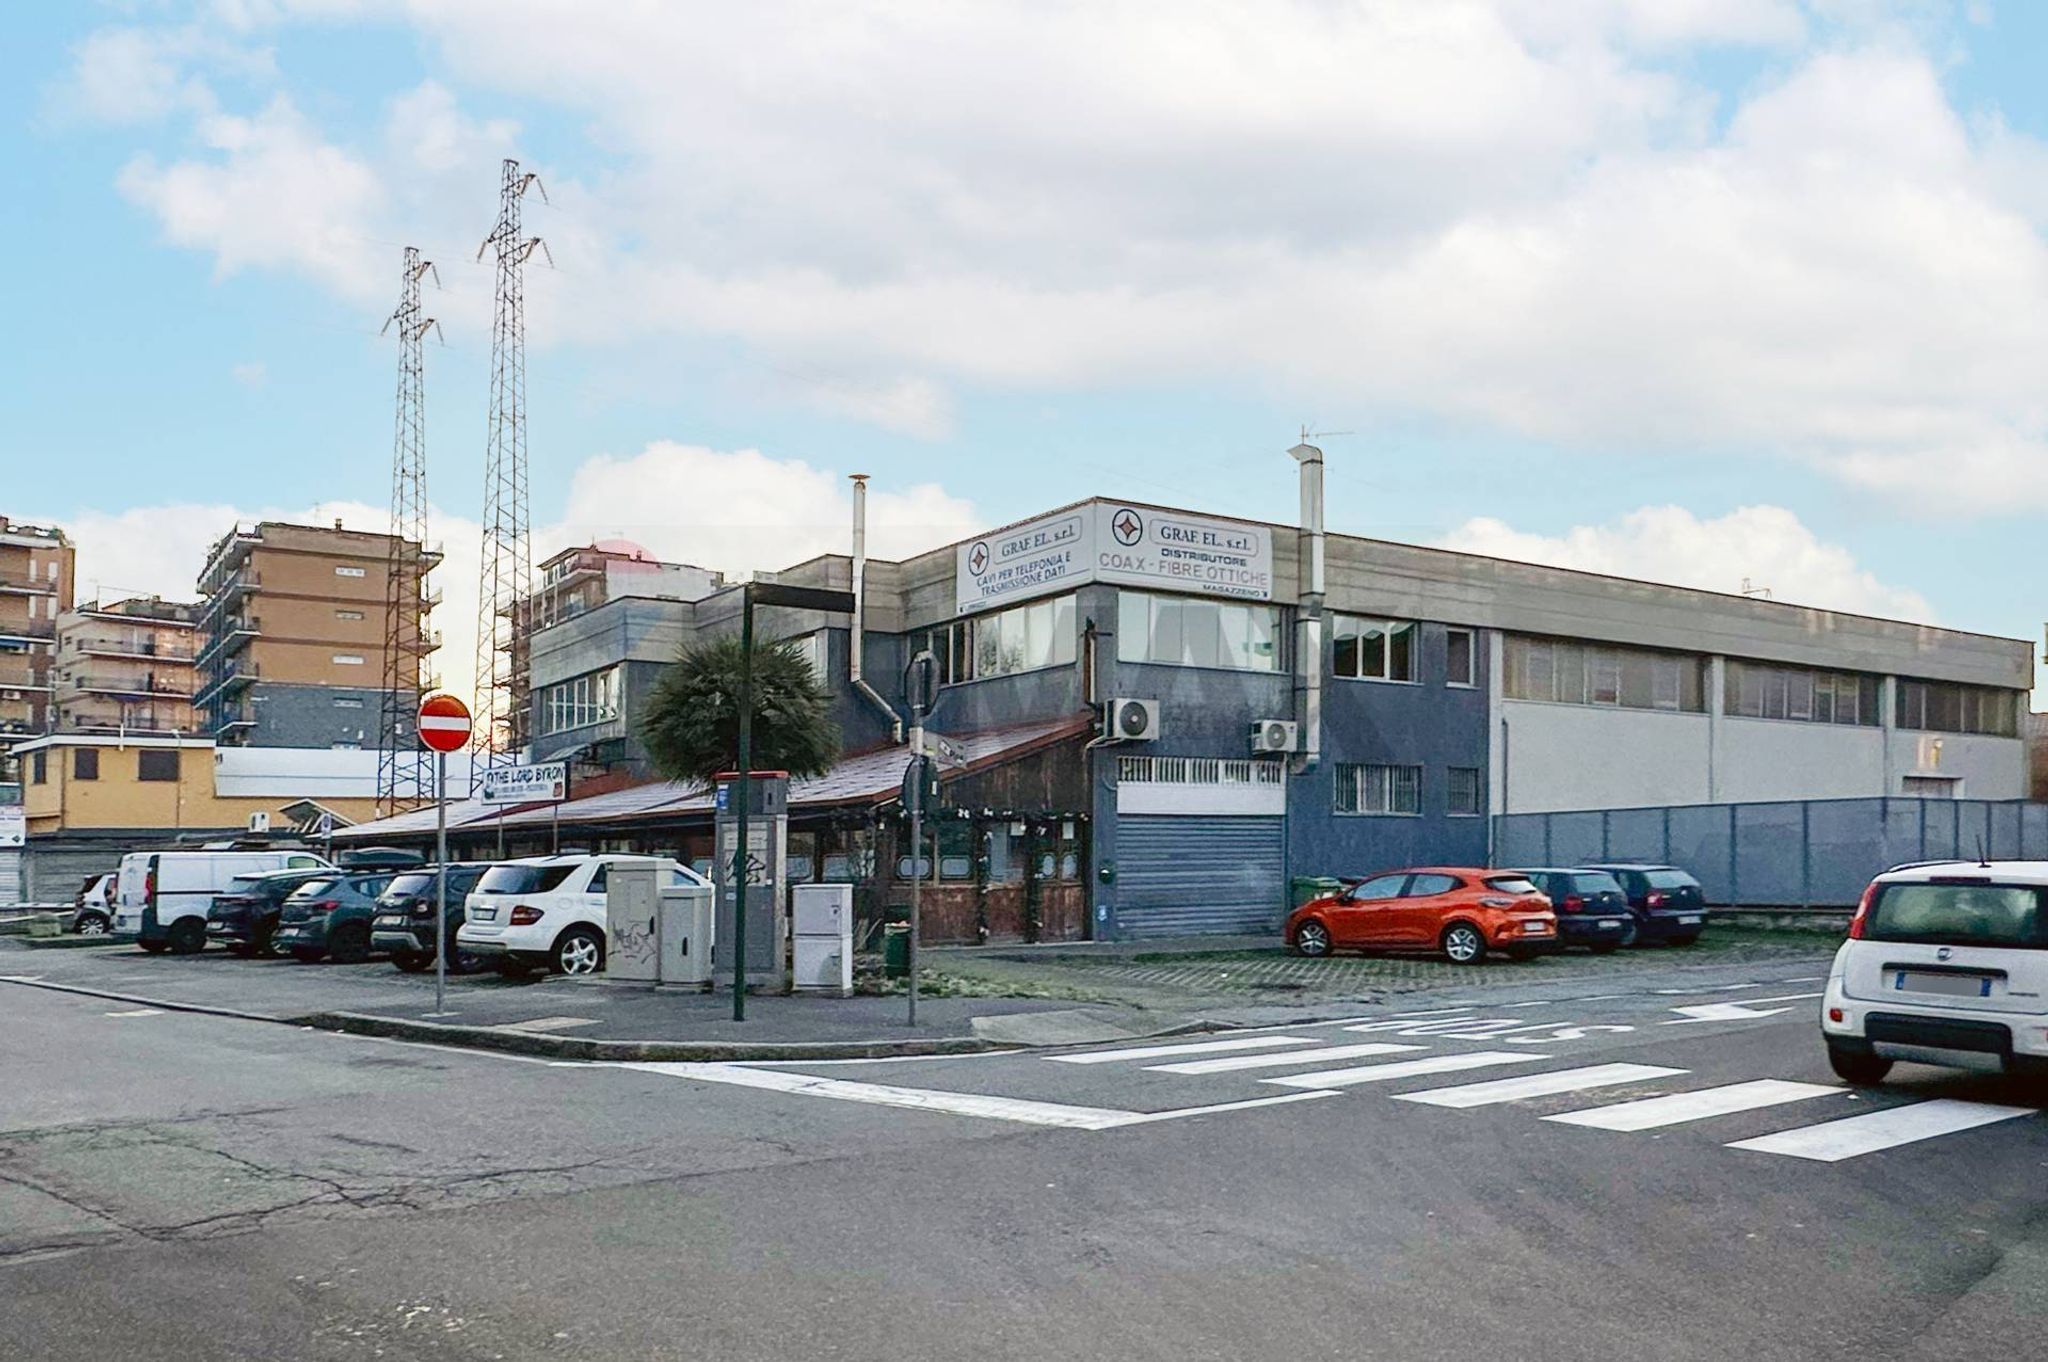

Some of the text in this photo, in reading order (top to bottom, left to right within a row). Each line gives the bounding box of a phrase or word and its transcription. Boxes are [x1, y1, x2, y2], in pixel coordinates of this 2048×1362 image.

[977, 551, 1071, 588] CAVI PER TELEFONIA E
[1098, 552, 1146, 571] COAX
[1159, 559, 1204, 577] FIBRE
[1206, 565, 1269, 586] OTTICHE
[1161, 548, 1247, 566] DISTRIBUTORE
[981, 565, 1066, 597] TRASMISSIONE DATI
[494, 766, 565, 785] THE LORD BYRON
